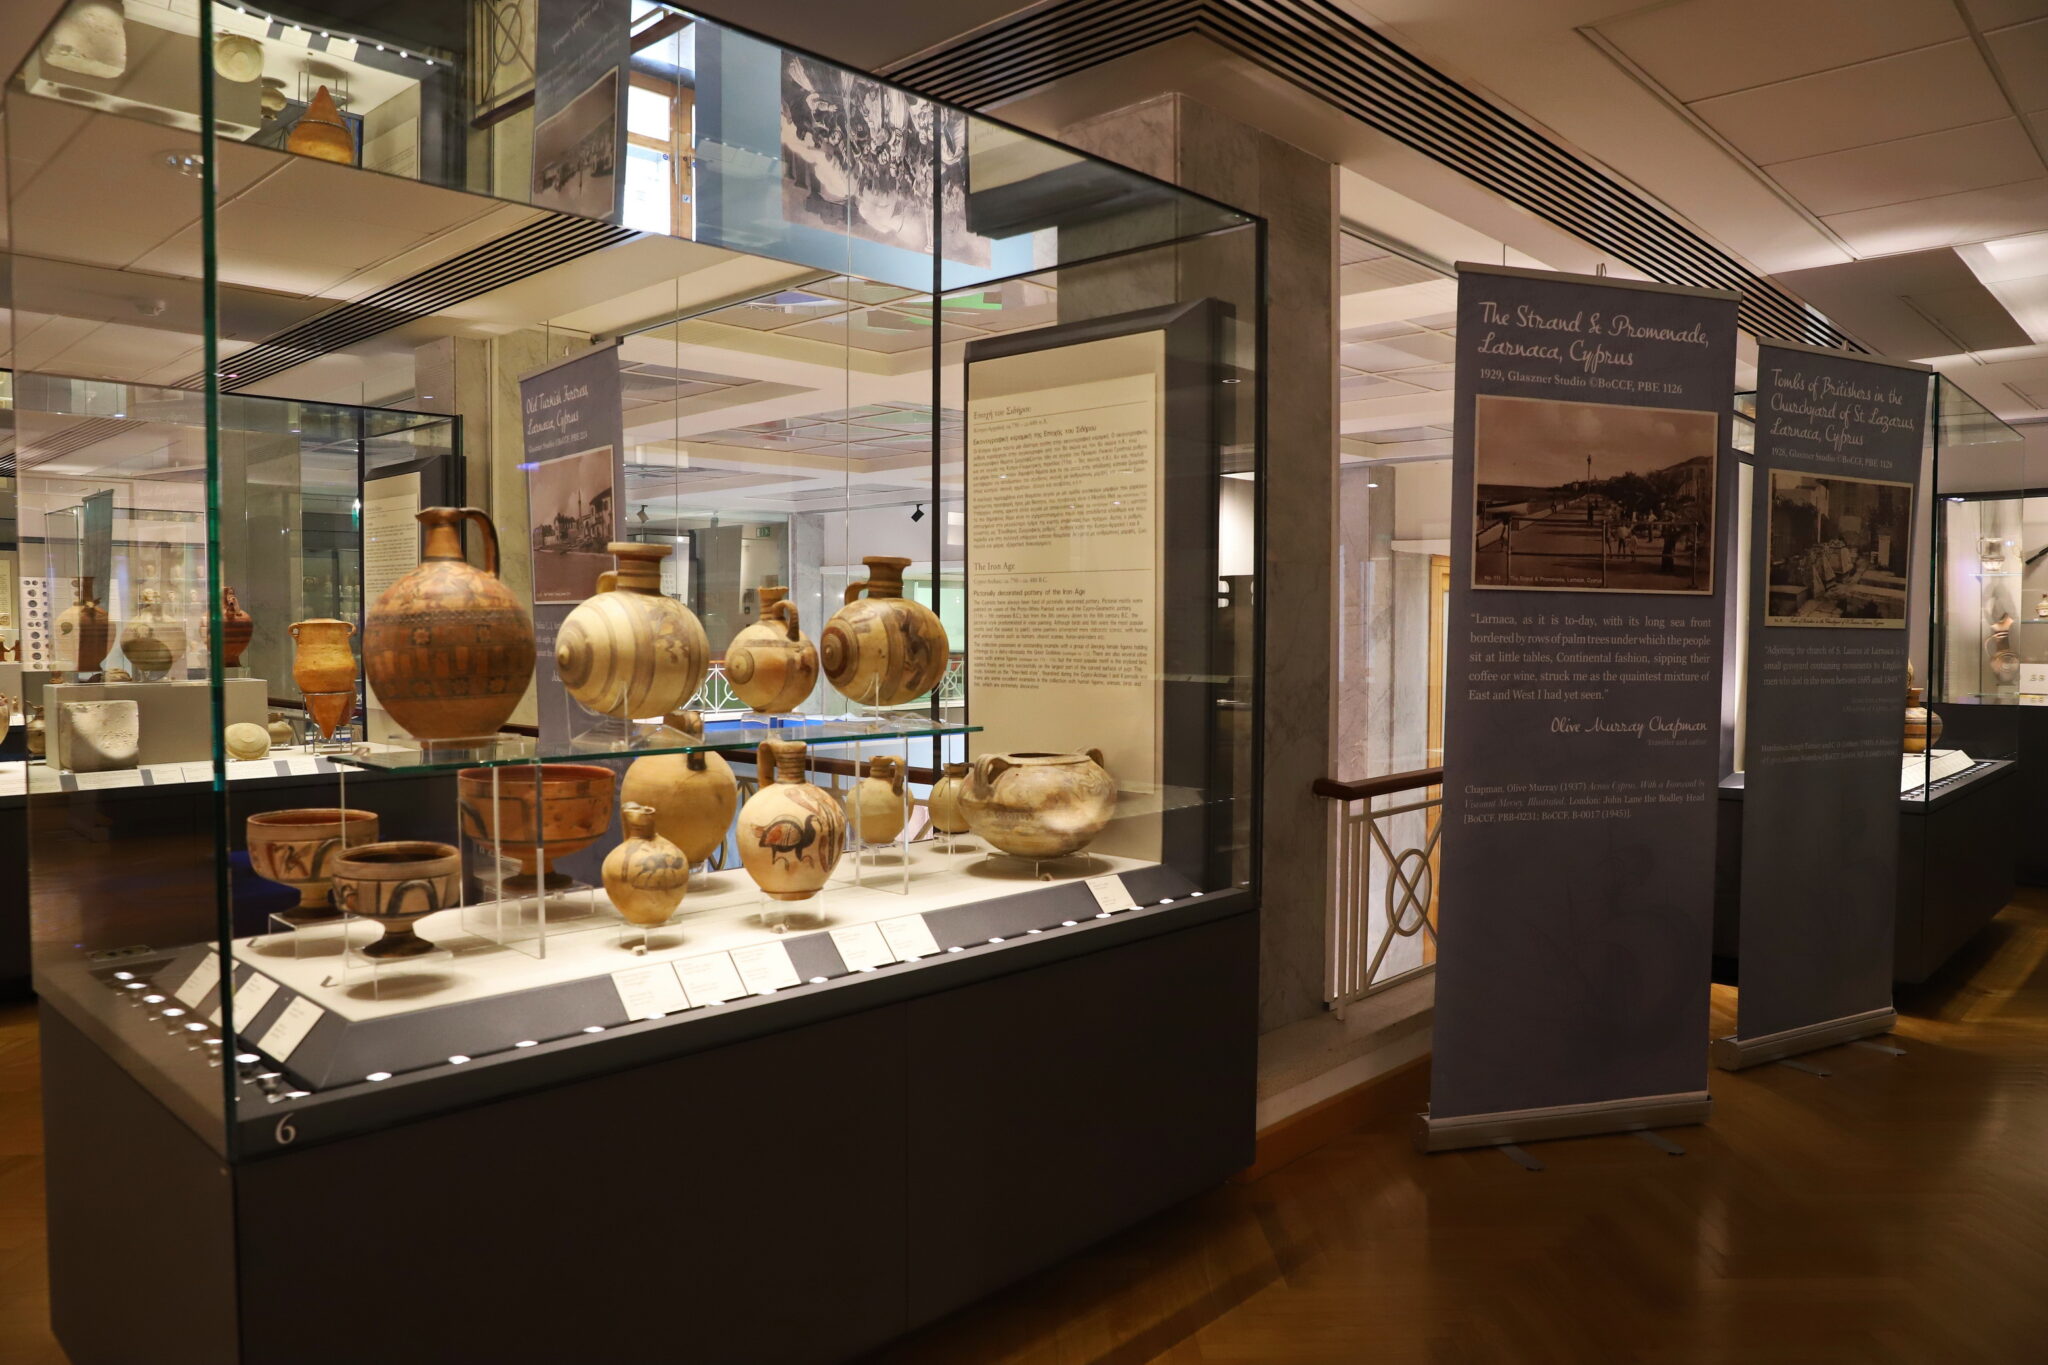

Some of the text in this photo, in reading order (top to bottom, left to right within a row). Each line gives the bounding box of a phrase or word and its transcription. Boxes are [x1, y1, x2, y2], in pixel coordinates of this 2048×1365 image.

[1478, 302, 1509, 326] The
[1515, 305, 1583, 333] Strand
[1608, 314, 1709, 348] Promenade,
[1478, 331, 1633, 374] Larnaca, Cyprus
[1480, 368, 1505, 382] 1929,
[1554, 374, 1586, 387] Studio
[1638, 381, 1660, 393] PBE
[1663, 383, 1683, 395] 1126
[1771, 368, 1805, 391] Tombs
[1807, 376, 1820, 400] of
[1874, 386, 1884, 403] in
[1889, 388, 1903, 406] the
[1770, 393, 1836, 424] Churchyard
[1839, 404, 1851, 429] of
[1868, 408, 1915, 433] Lazarus,
[1770, 418, 1864, 452] Larnaca, Cyprus
[1522, 616, 1533, 625] as
[1538, 614, 1545, 625] it
[1551, 614, 1559, 625] is
[1565, 614, 1597, 628] to-day,
[1603, 615, 1623, 627] with
[1628, 615, 1640, 627] its
[1645, 615, 1666, 630] long
[1670, 619, 1685, 628] sea
[1690, 617, 1711, 628] front
[1470, 631, 1711, 648] bordered by rows of palm trees under which the people
[1469, 652, 1482, 662] sit
[1485, 653, 1495, 662] at
[1499, 651, 1520, 662] little
[1523, 652, 1553, 664] tables,
[1556, 652, 1612, 663] Continental
[1653, 653, 1688, 665] sipping
[1690, 653, 1711, 663] their
[1468, 670, 1498, 681] coffee
[1500, 673, 1511, 681] or
[1540, 670, 1570, 681] struck
[1572, 672, 1588, 681] me
[1590, 673, 1600, 681] as
[1603, 670, 1618, 681] the
[1620, 670, 1661, 684] quaintest
[1664, 671, 1700, 681] mixture
[1469, 689, 1490, 700] East
[1492, 689, 1510, 700] and
[1513, 689, 1535, 700] West
[1537, 689, 1541, 700] I
[1544, 689, 1562, 700] had
[1564, 690, 1578, 703] yet
[1551, 715, 1709, 740] Olive Murray Chapman
[1506, 784, 1527, 793] Olive
[1529, 783, 1558, 794] Murray
[275, 1112, 297, 1145] 6
